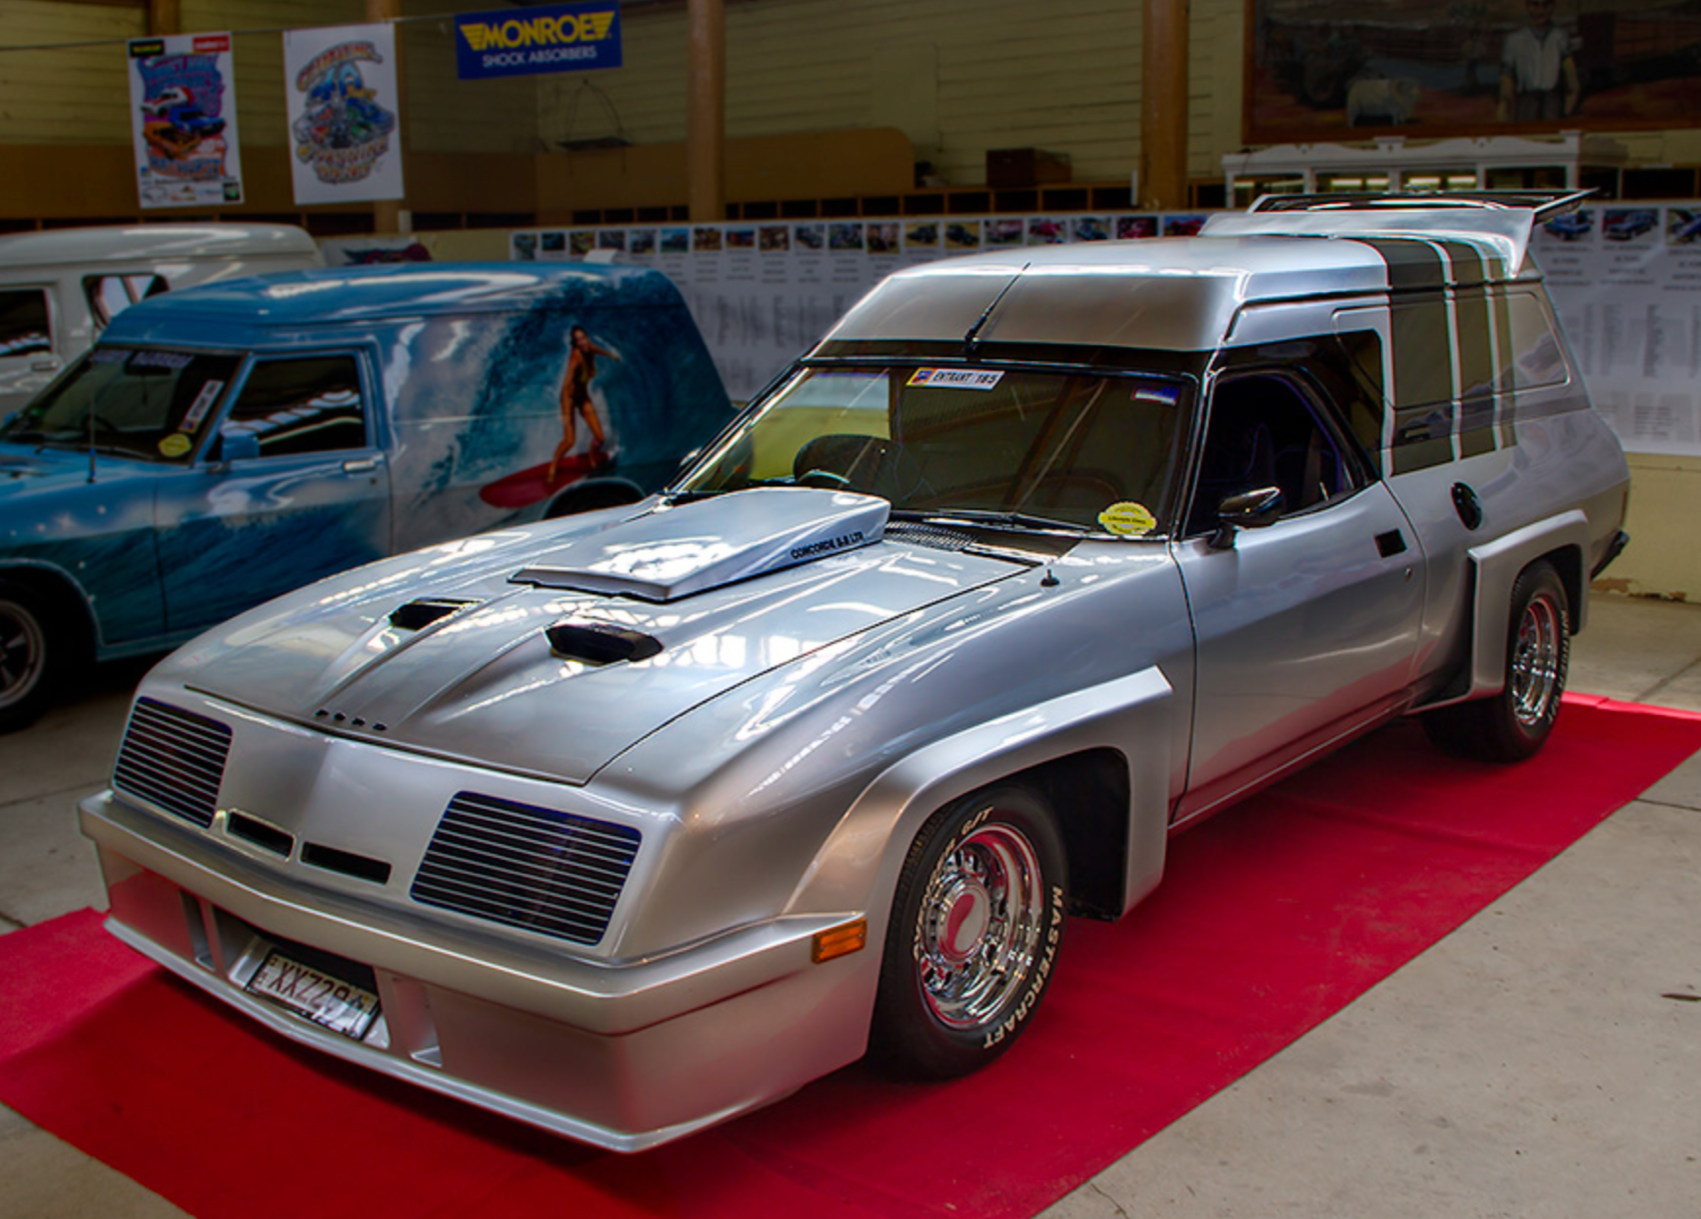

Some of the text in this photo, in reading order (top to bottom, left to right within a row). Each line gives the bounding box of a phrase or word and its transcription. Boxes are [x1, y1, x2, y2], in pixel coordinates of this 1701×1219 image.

[481, 13, 596, 50] MONROE
[482, 45, 599, 69] SHOCK ABSORBERS
[983, 886, 1064, 1049] MASTERCRAFT
